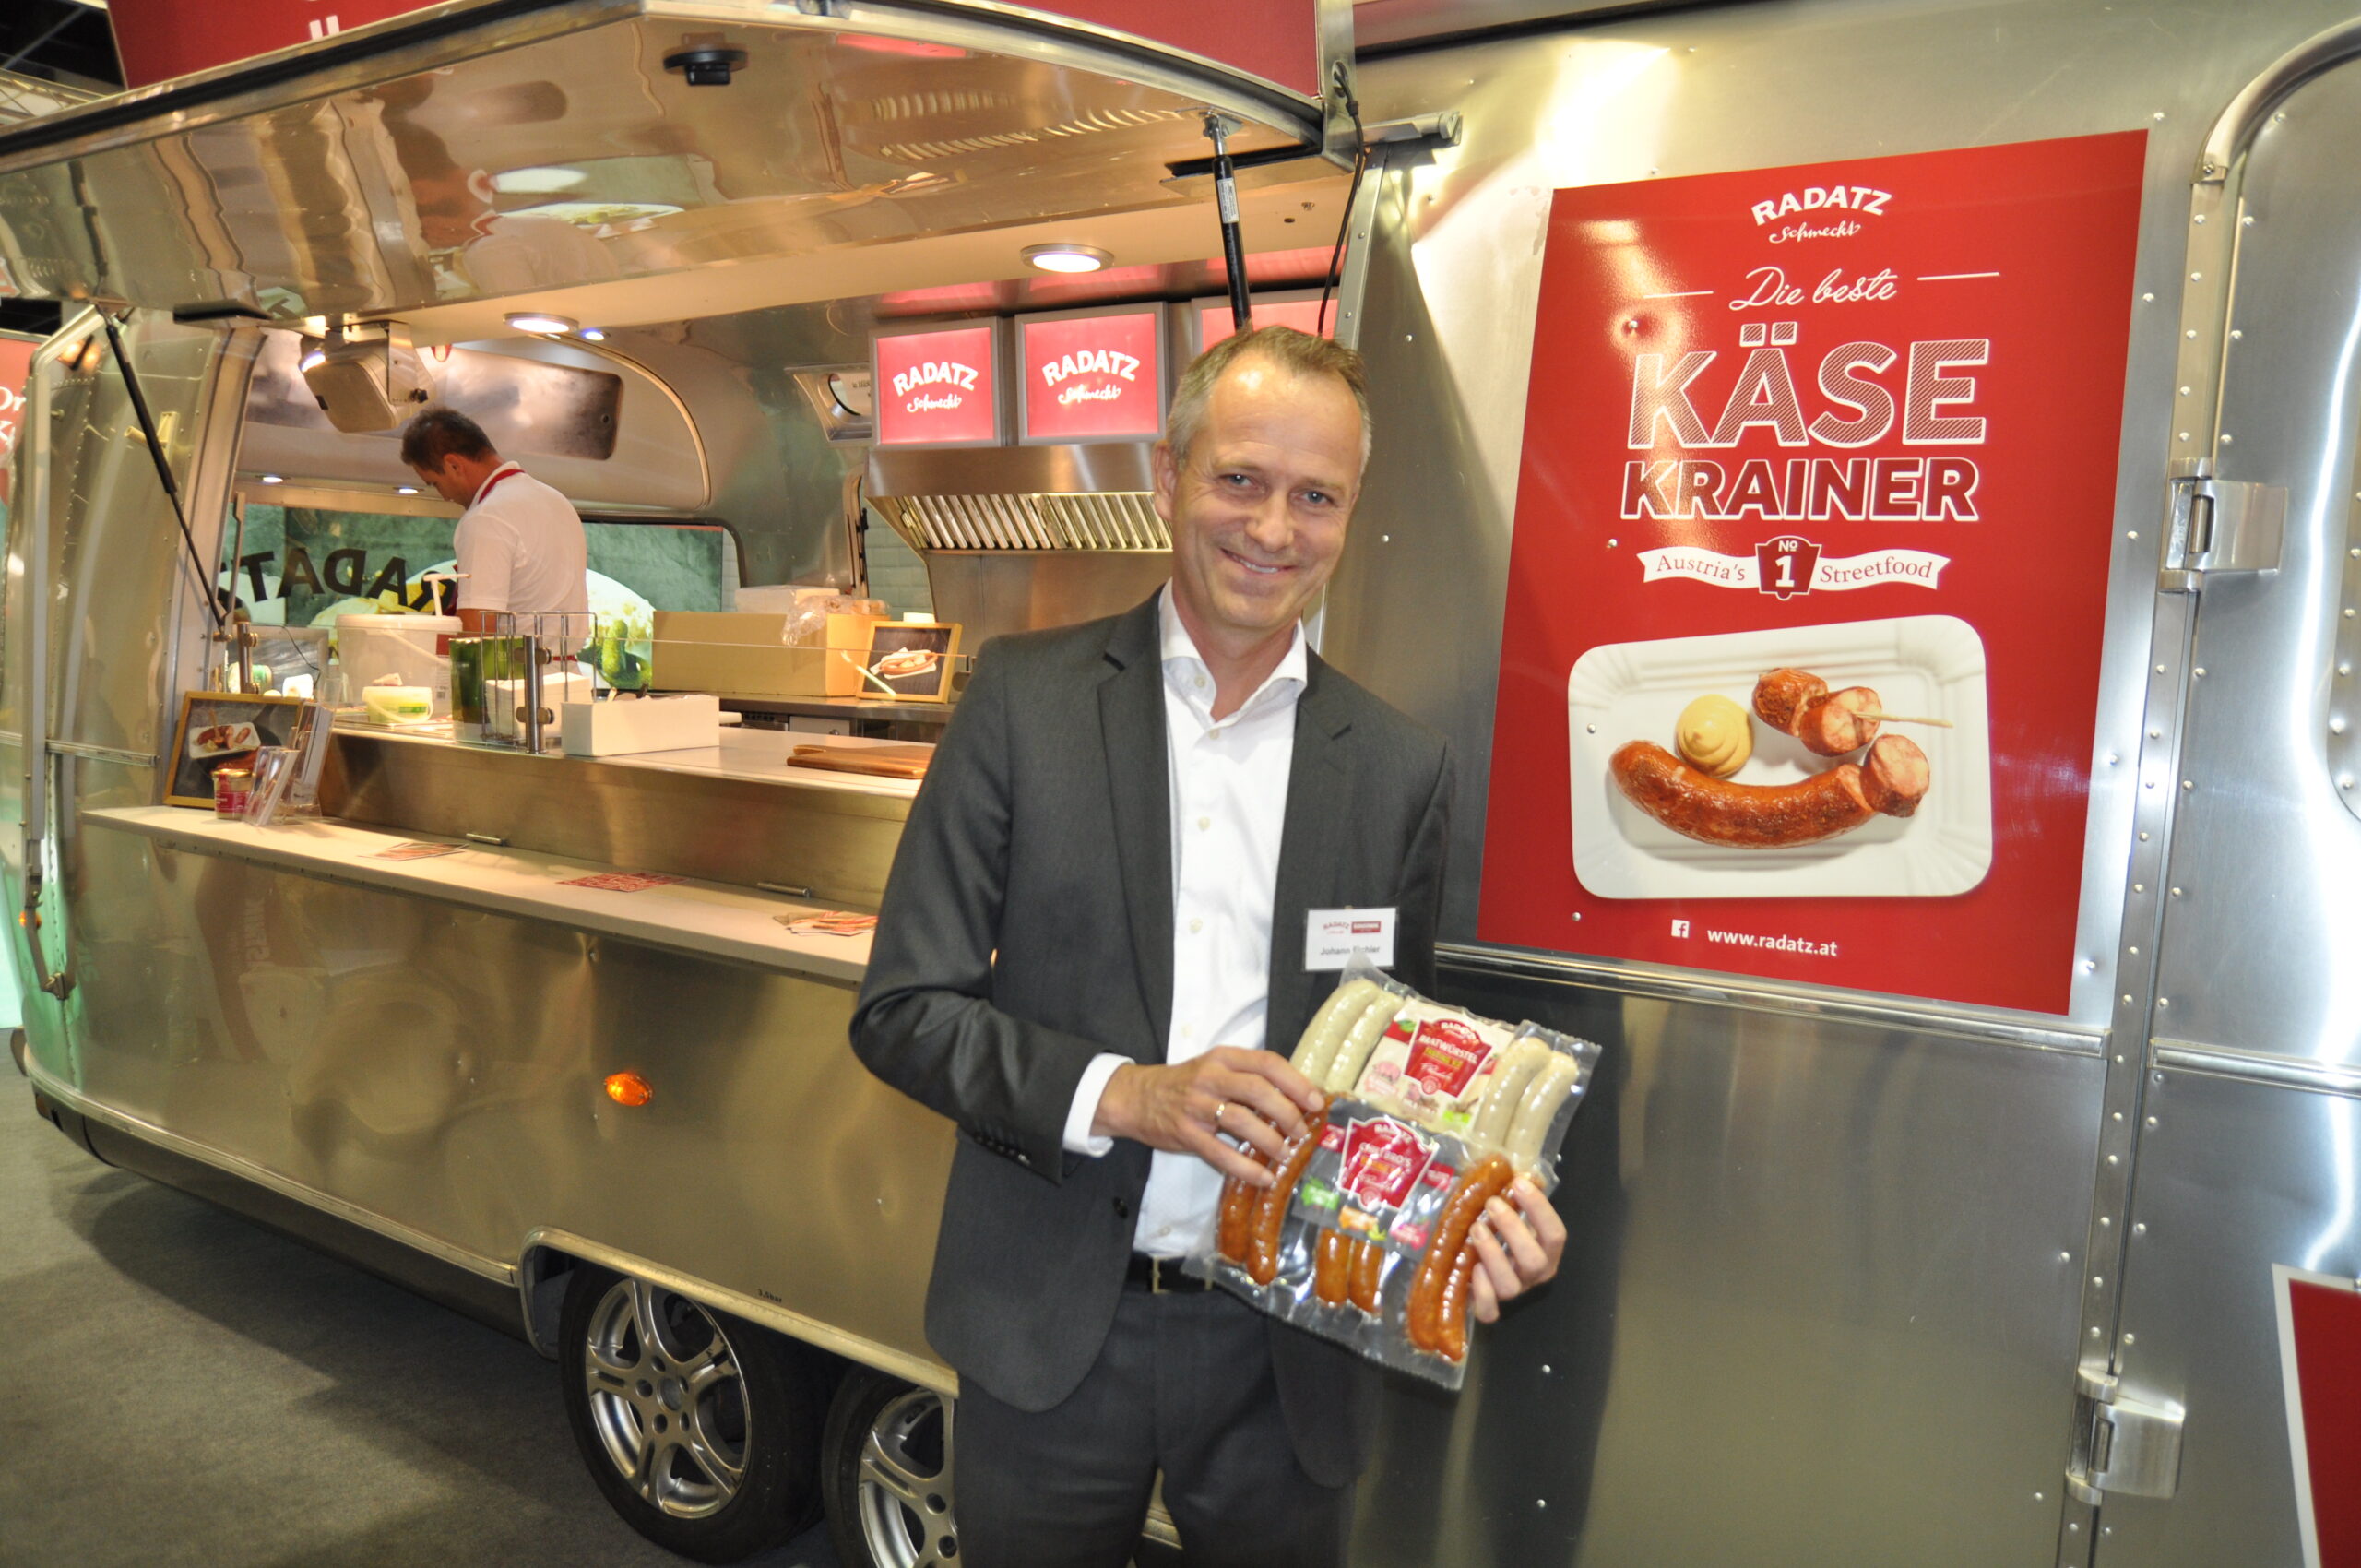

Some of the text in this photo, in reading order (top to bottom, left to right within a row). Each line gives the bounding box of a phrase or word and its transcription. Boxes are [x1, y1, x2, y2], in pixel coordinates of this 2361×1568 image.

[1750, 185, 1892, 226] RADATZ
[1768, 220, 1862, 244] Schmeckt
[1728, 266, 1898, 311] Die beste
[892, 361, 979, 397] RADATZ
[1041, 350, 1141, 387] RADATZ
[1627, 321, 1989, 449] KÄSE
[1620, 457, 1980, 522] KRAINER
[1655, 553, 1933, 588] Austria's 1 Streetfood
[1707, 930, 1838, 956] www.radatz.at
